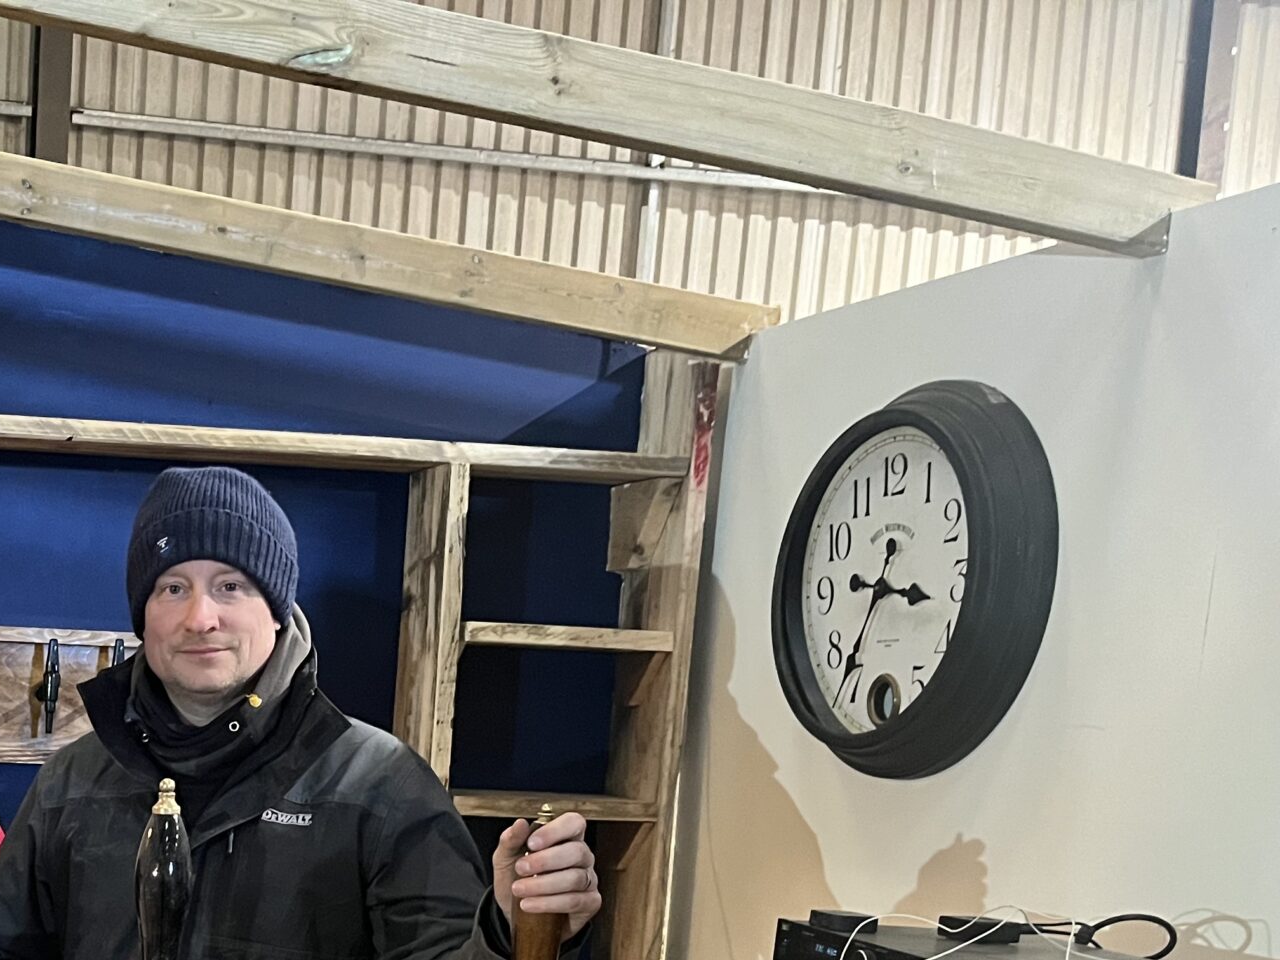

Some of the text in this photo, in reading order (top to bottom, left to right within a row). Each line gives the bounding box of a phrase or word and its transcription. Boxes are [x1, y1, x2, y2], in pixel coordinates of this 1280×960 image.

[882, 452, 908, 497] 12
[924, 461, 932, 504] 1
[852, 476, 872, 519] 11
[828, 521, 852, 562] 10
[943, 498, 962, 544] 2
[816, 576, 835, 616] 9
[827, 630, 842, 669] 8
